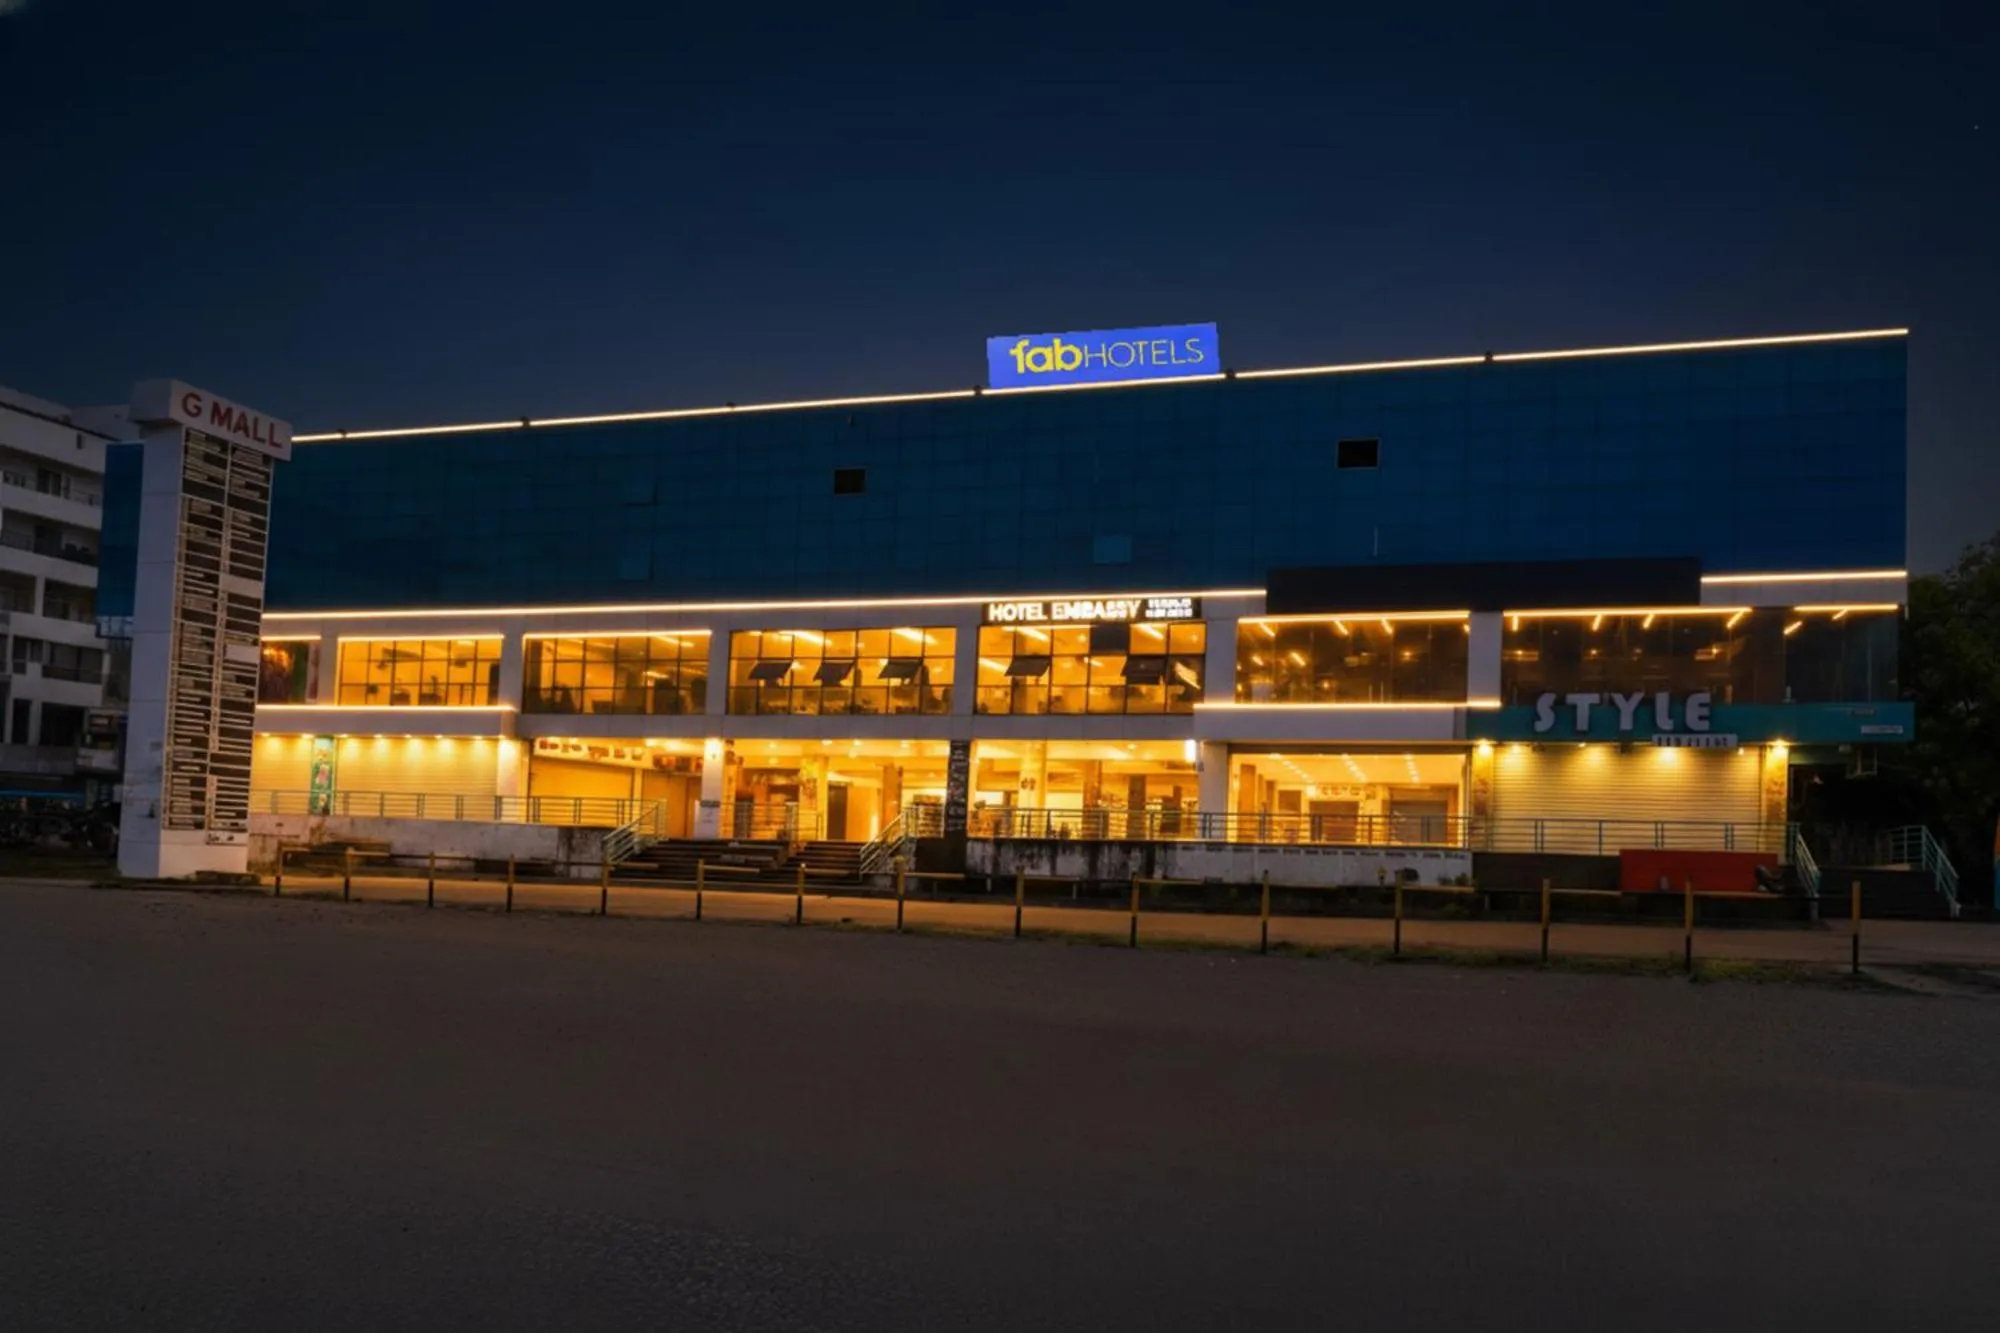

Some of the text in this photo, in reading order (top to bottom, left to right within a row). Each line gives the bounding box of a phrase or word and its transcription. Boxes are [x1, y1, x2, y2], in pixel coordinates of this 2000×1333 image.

[1009, 337, 1205, 374] fabHOTELS
[182, 392, 283, 448] G MALL
[988, 602, 1048, 621] HOTEL
[1534, 692, 1712, 733] STYLE
